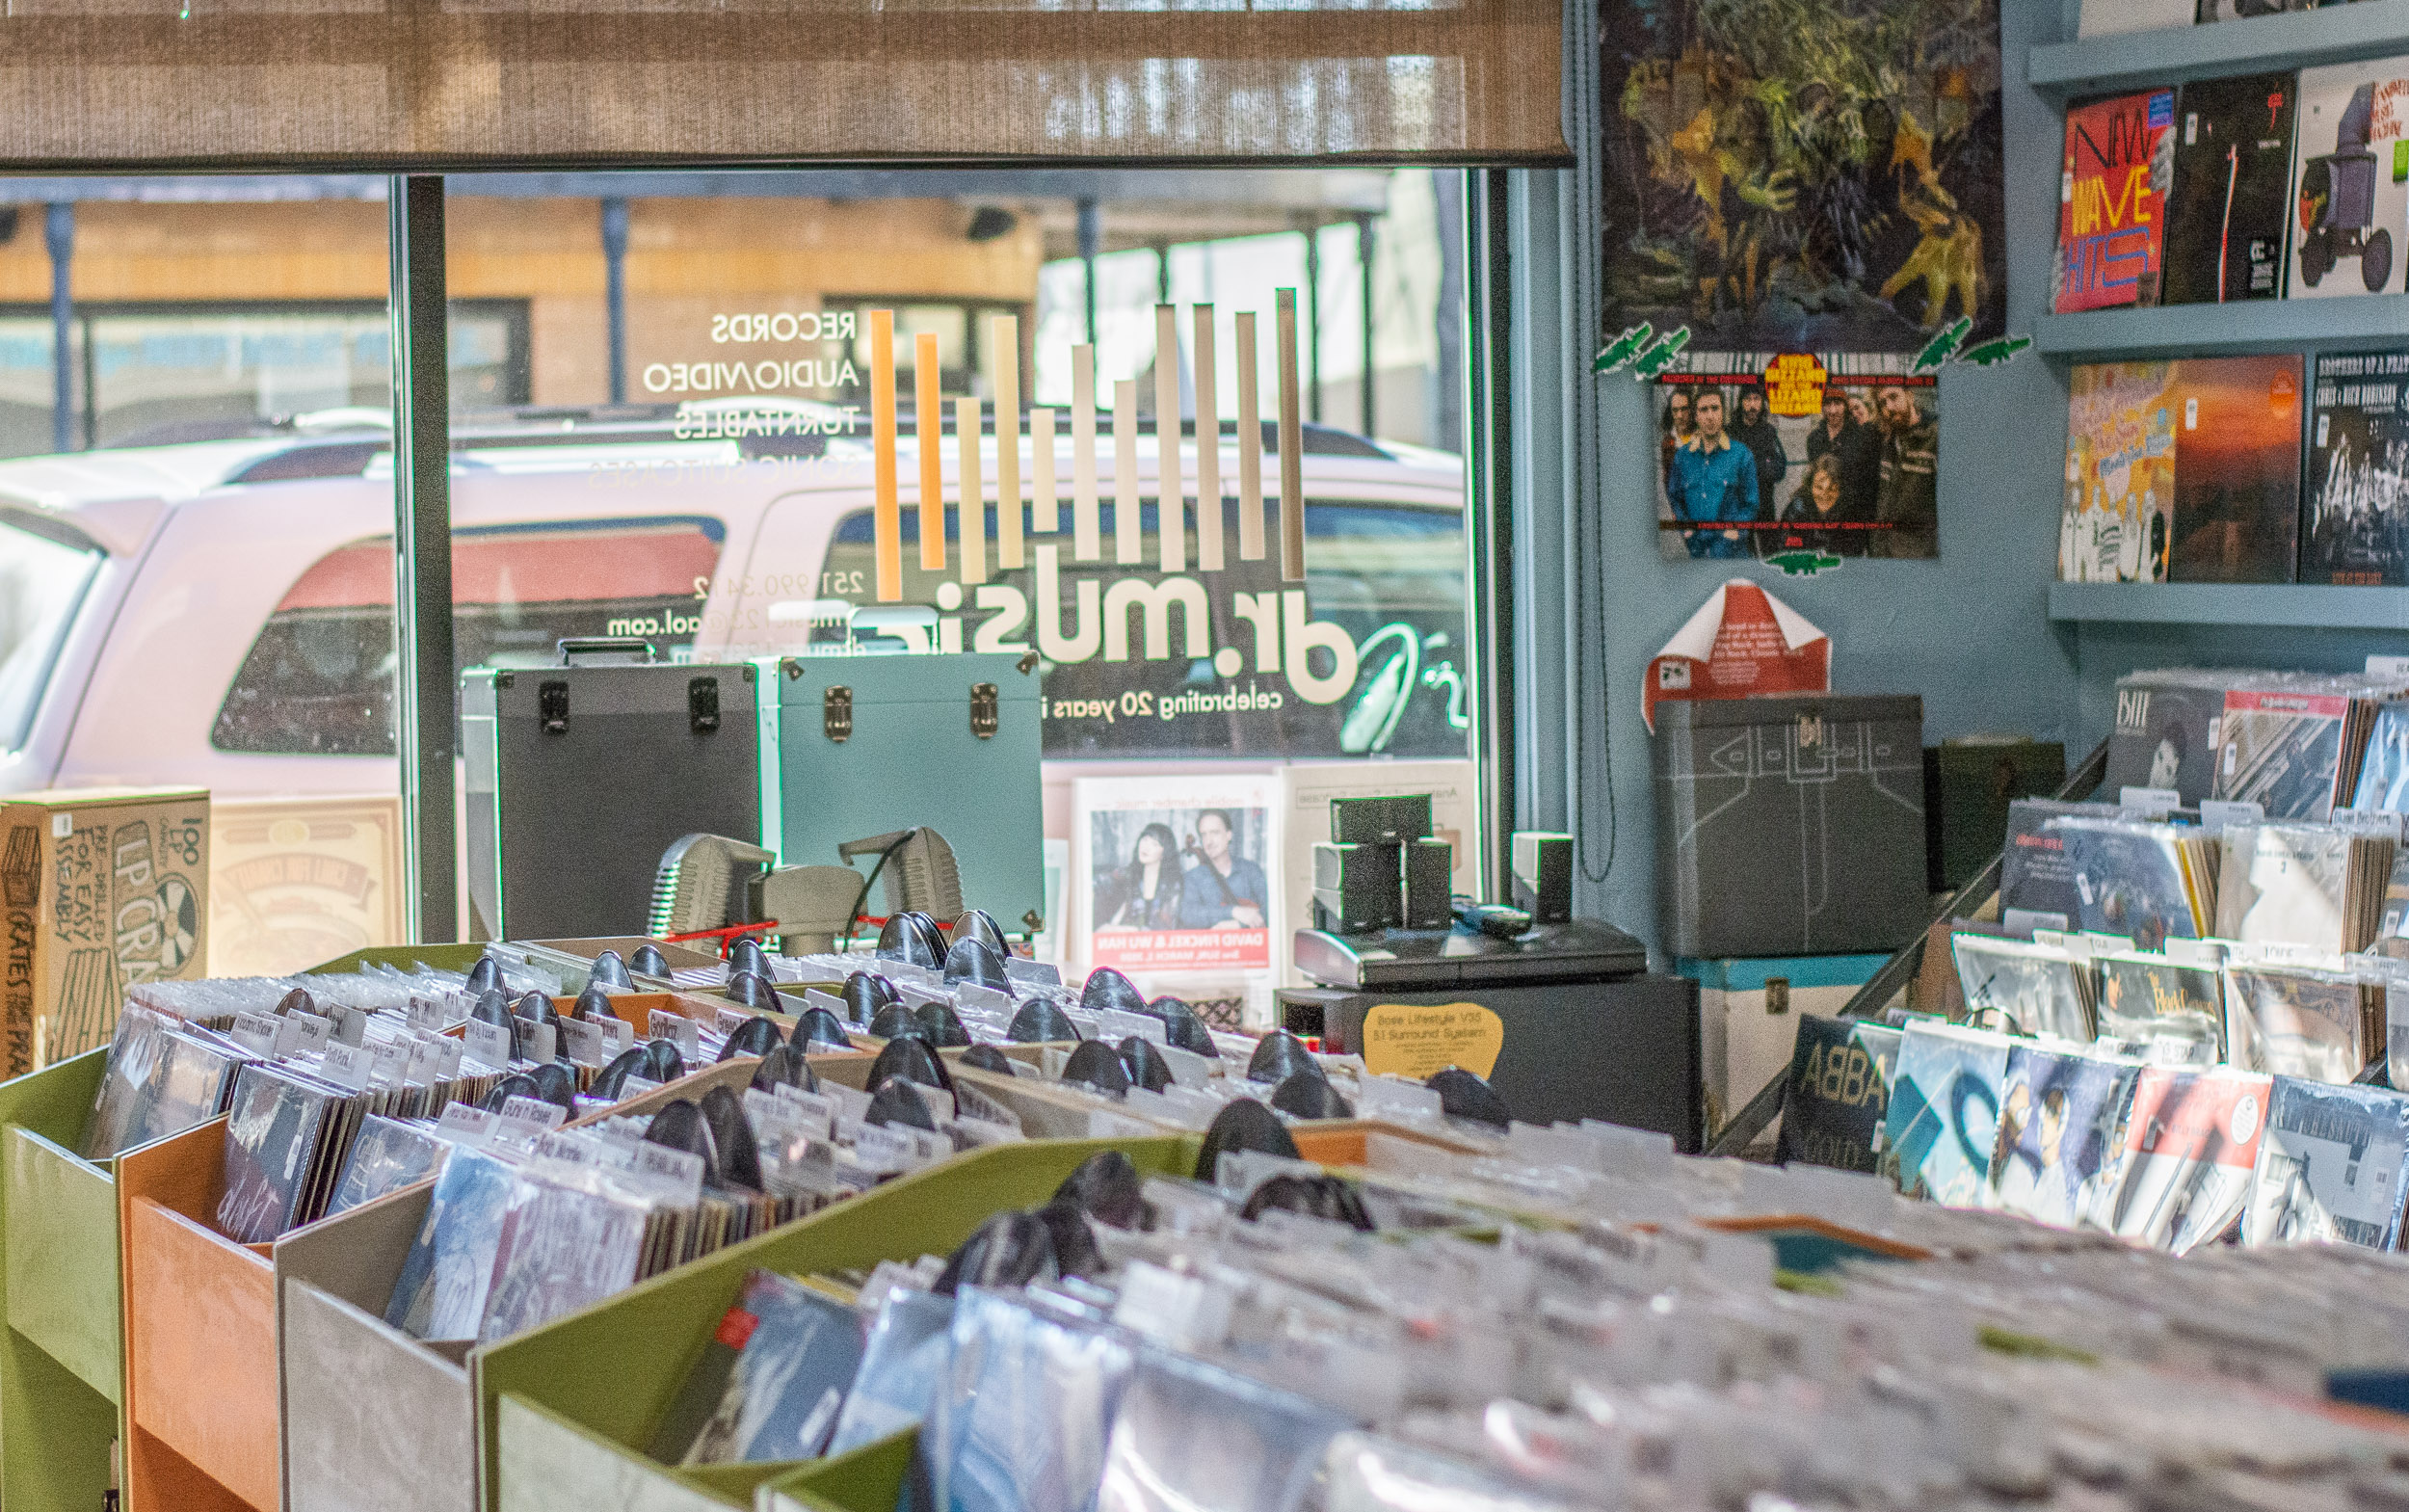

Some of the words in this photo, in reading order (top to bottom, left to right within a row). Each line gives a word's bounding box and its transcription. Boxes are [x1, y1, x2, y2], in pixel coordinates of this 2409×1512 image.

[2073, 165, 2152, 236] WAVE
[2065, 226, 2150, 294] HITS
[74, 827, 93, 879] FOR
[115, 837, 150, 888] LP
[169, 828, 183, 854] LP
[183, 817, 203, 866] 100
[55, 835, 73, 942] ASSEMBLY
[94, 824, 109, 942] PRE-DRILLED
[72, 885, 92, 941] EASY
[116, 896, 162, 993] CRA
[1377, 1015, 1404, 1025] Bose
[1408, 1012, 1456, 1026] Lifestyle
[1389, 1028, 1440, 1041] Surround
[1443, 1027, 1487, 1042] System
[1799, 1040, 1889, 1112] ABBA
